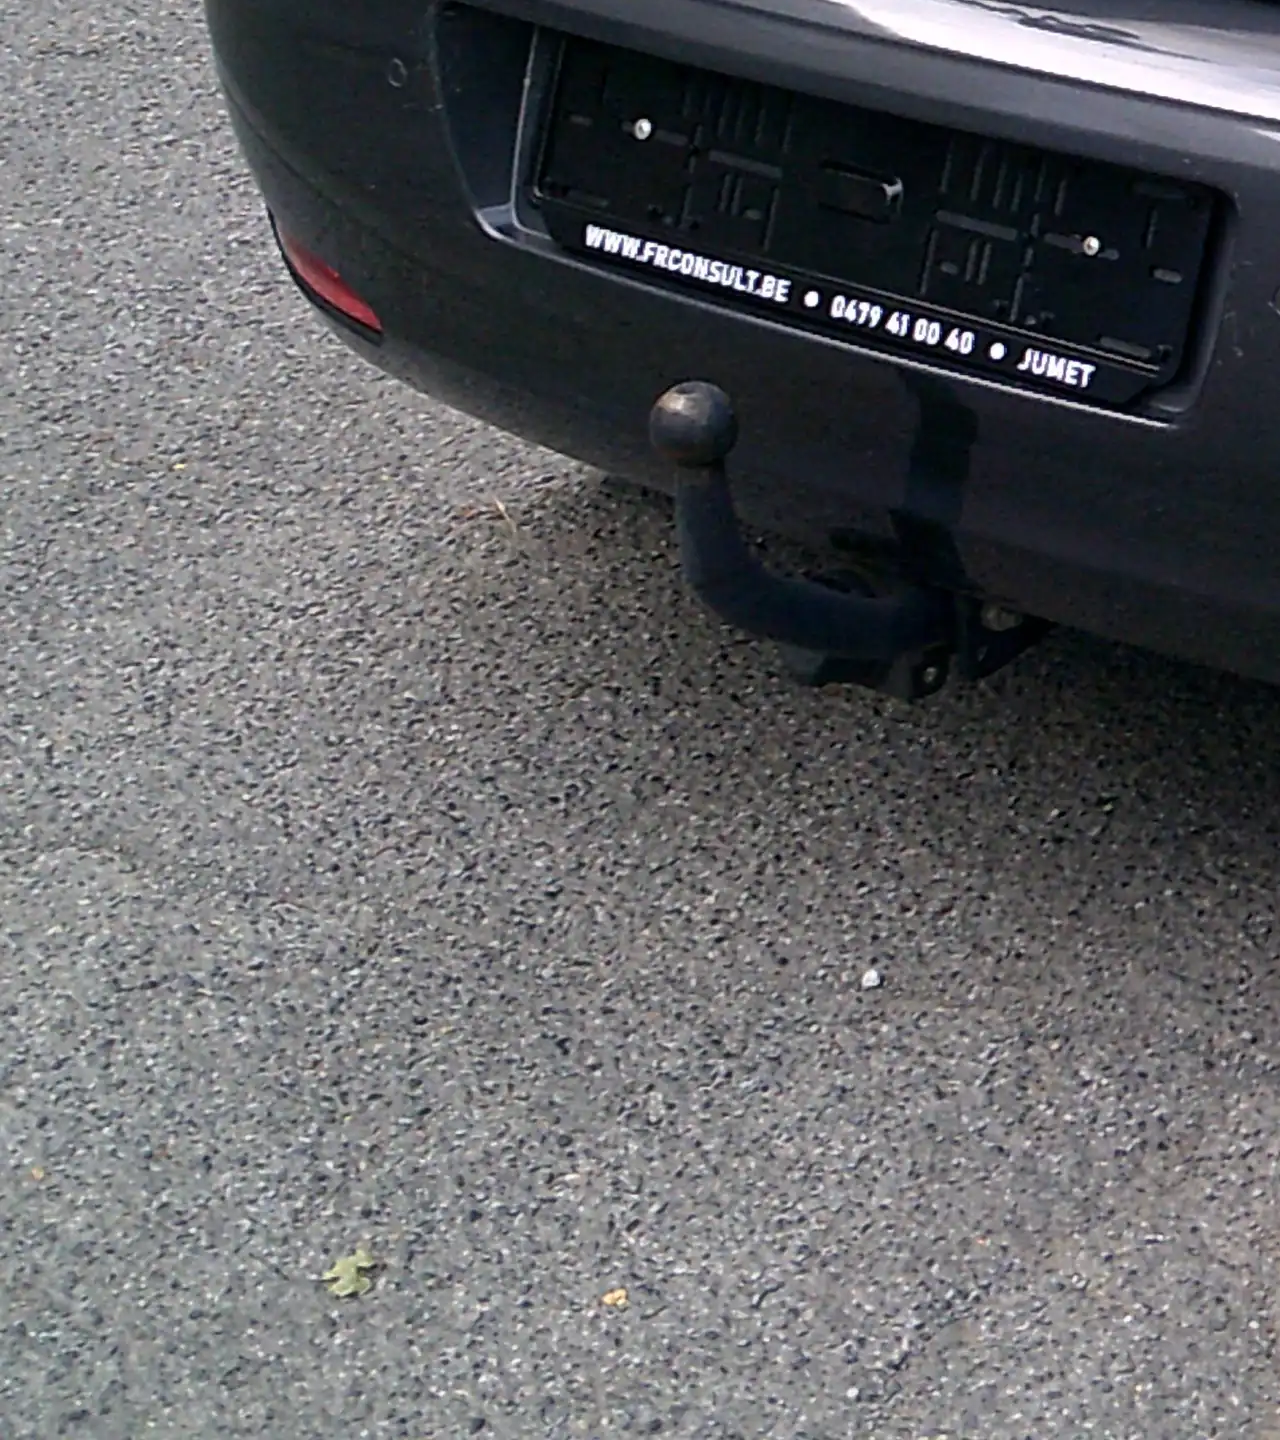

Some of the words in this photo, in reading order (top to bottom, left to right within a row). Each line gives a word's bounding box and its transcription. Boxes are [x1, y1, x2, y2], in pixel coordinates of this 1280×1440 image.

[584, 223, 793, 304] WWW.FRCONSULT.BE
[829, 294, 882, 328] 0479
[884, 311, 911, 337] 41
[912, 318, 943, 346] 00
[943, 327, 976, 356] 40
[1015, 347, 1098, 389] JUMET
